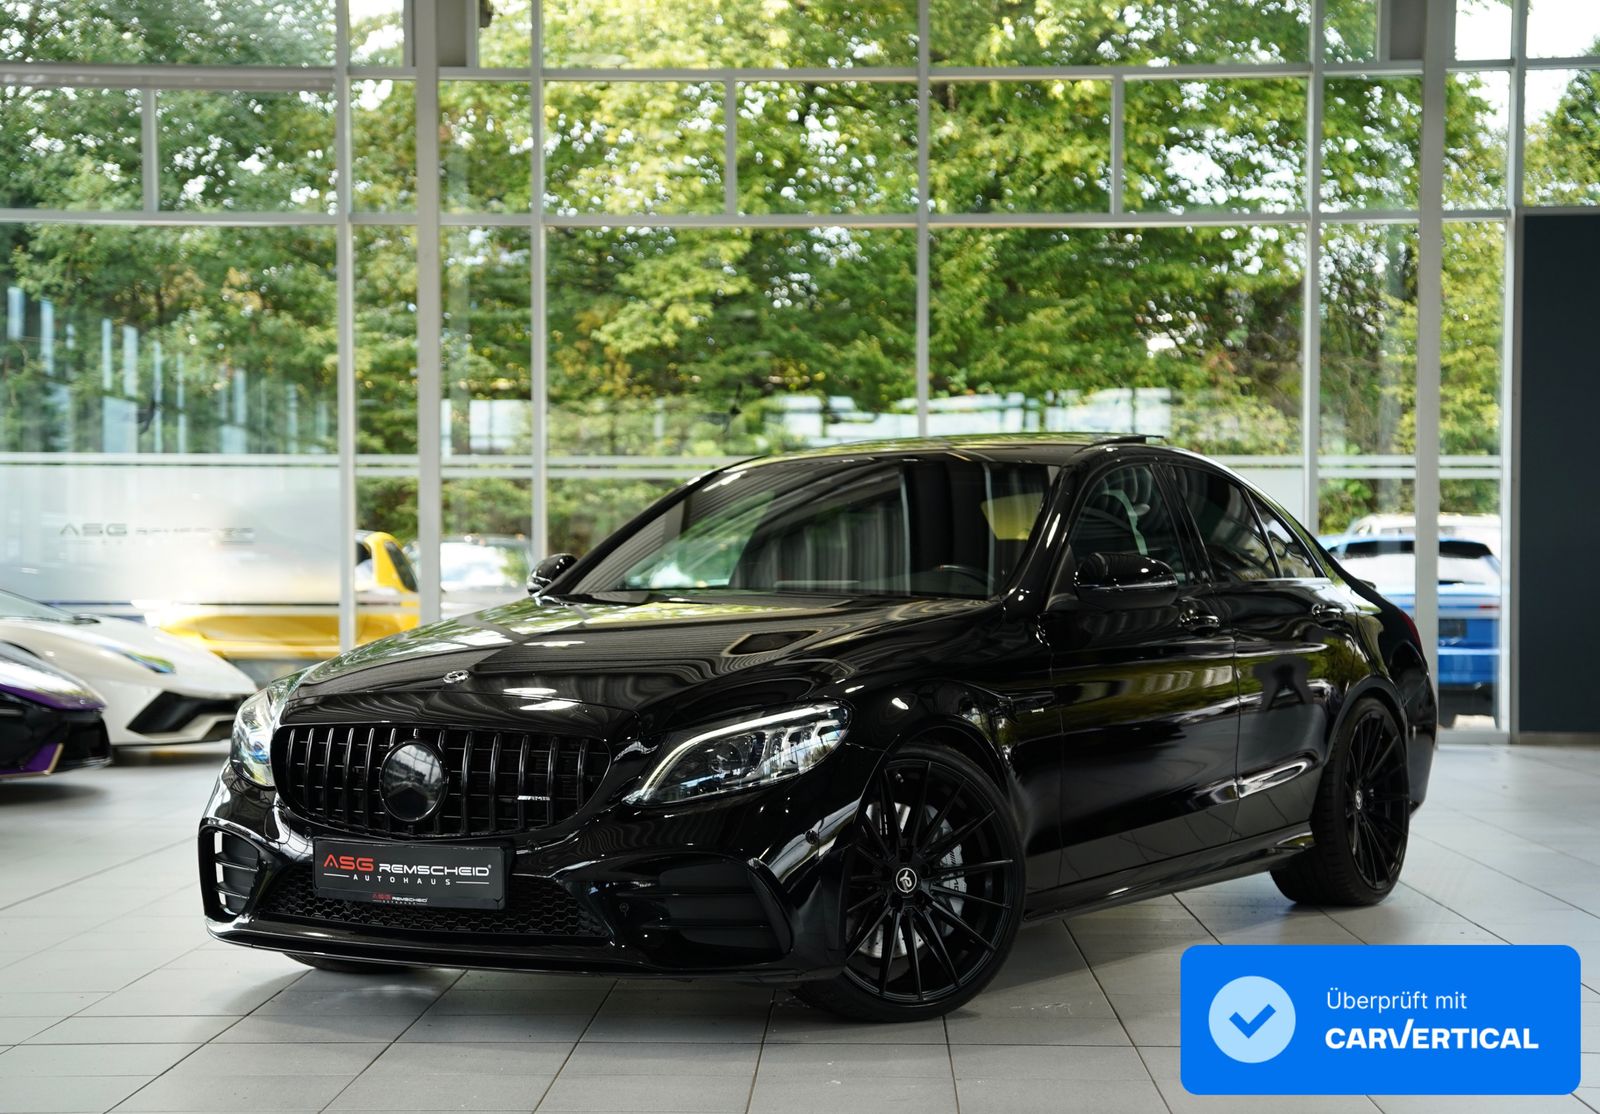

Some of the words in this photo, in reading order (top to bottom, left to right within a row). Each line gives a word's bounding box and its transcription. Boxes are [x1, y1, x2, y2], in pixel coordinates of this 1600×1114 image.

[324, 854, 374, 872] ASG
[379, 863, 491, 877] REMSCHEID
[353, 874, 451, 886] AUTOHAUS
